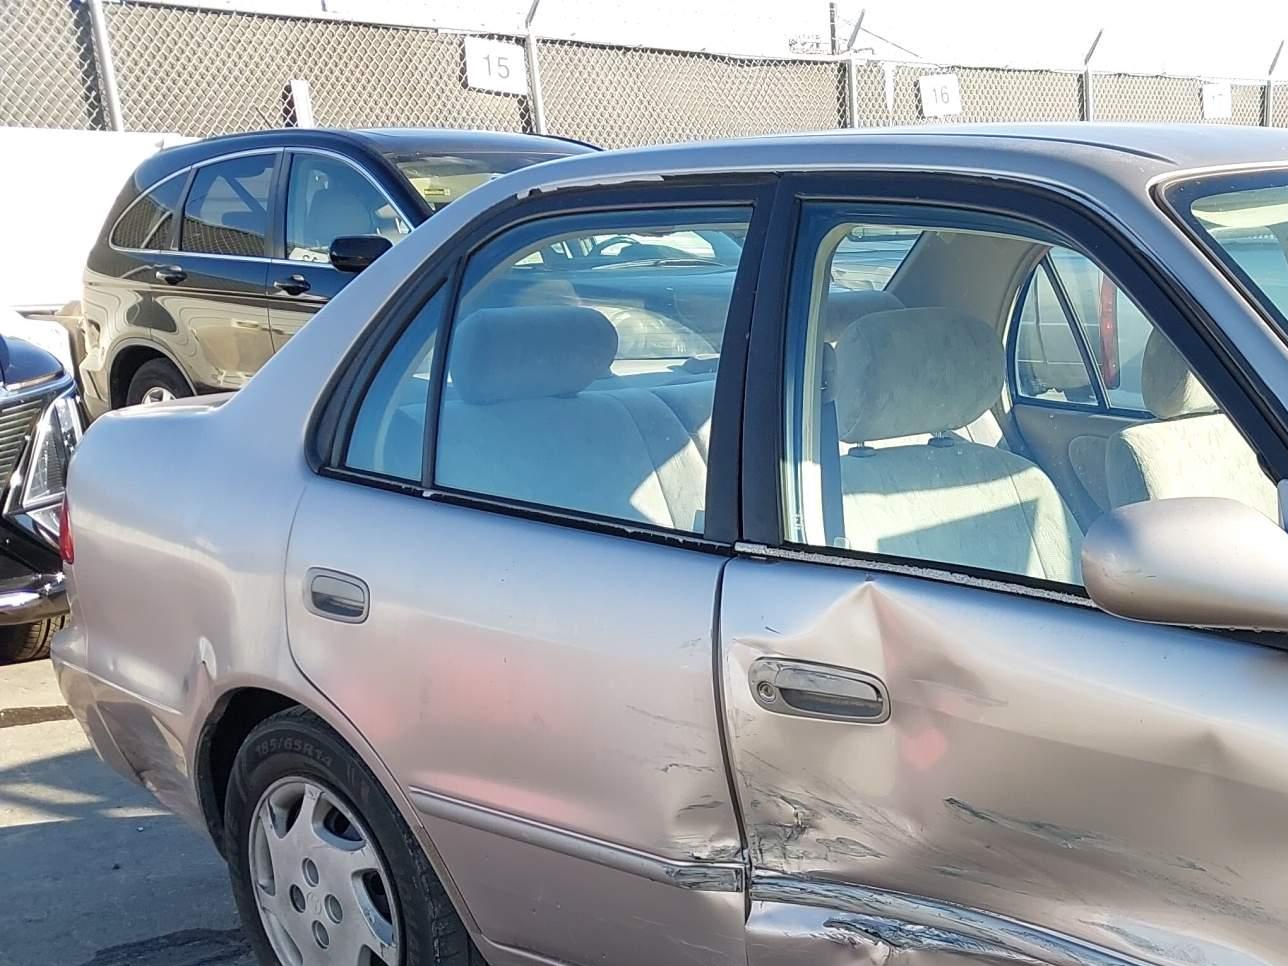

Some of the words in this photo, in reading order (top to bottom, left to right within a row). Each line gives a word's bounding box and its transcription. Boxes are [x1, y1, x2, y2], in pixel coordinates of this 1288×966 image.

[482, 54, 510, 79] 15
[932, 85, 950, 104] 16
[255, 738, 333, 767] 185/65R14
